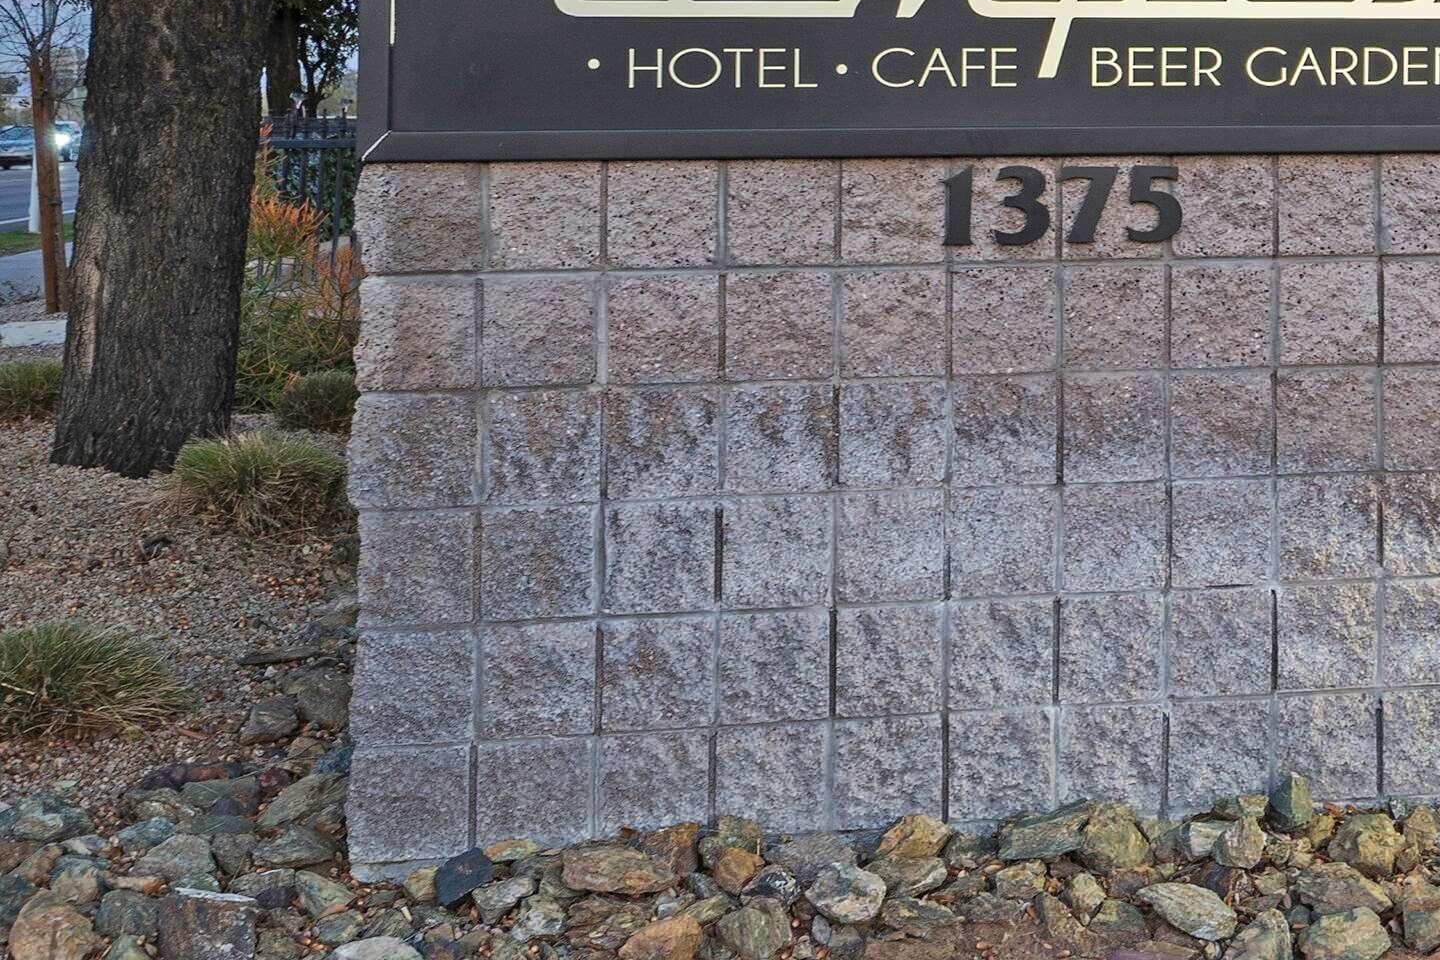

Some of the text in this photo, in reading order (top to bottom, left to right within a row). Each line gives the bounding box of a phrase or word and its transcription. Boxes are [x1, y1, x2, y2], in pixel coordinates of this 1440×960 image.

[627, 47, 819, 89] HOTEL
[871, 47, 1018, 88] CAFE
[1091, 46, 1223, 87] BEER
[942, 165, 1183, 247] 1375
